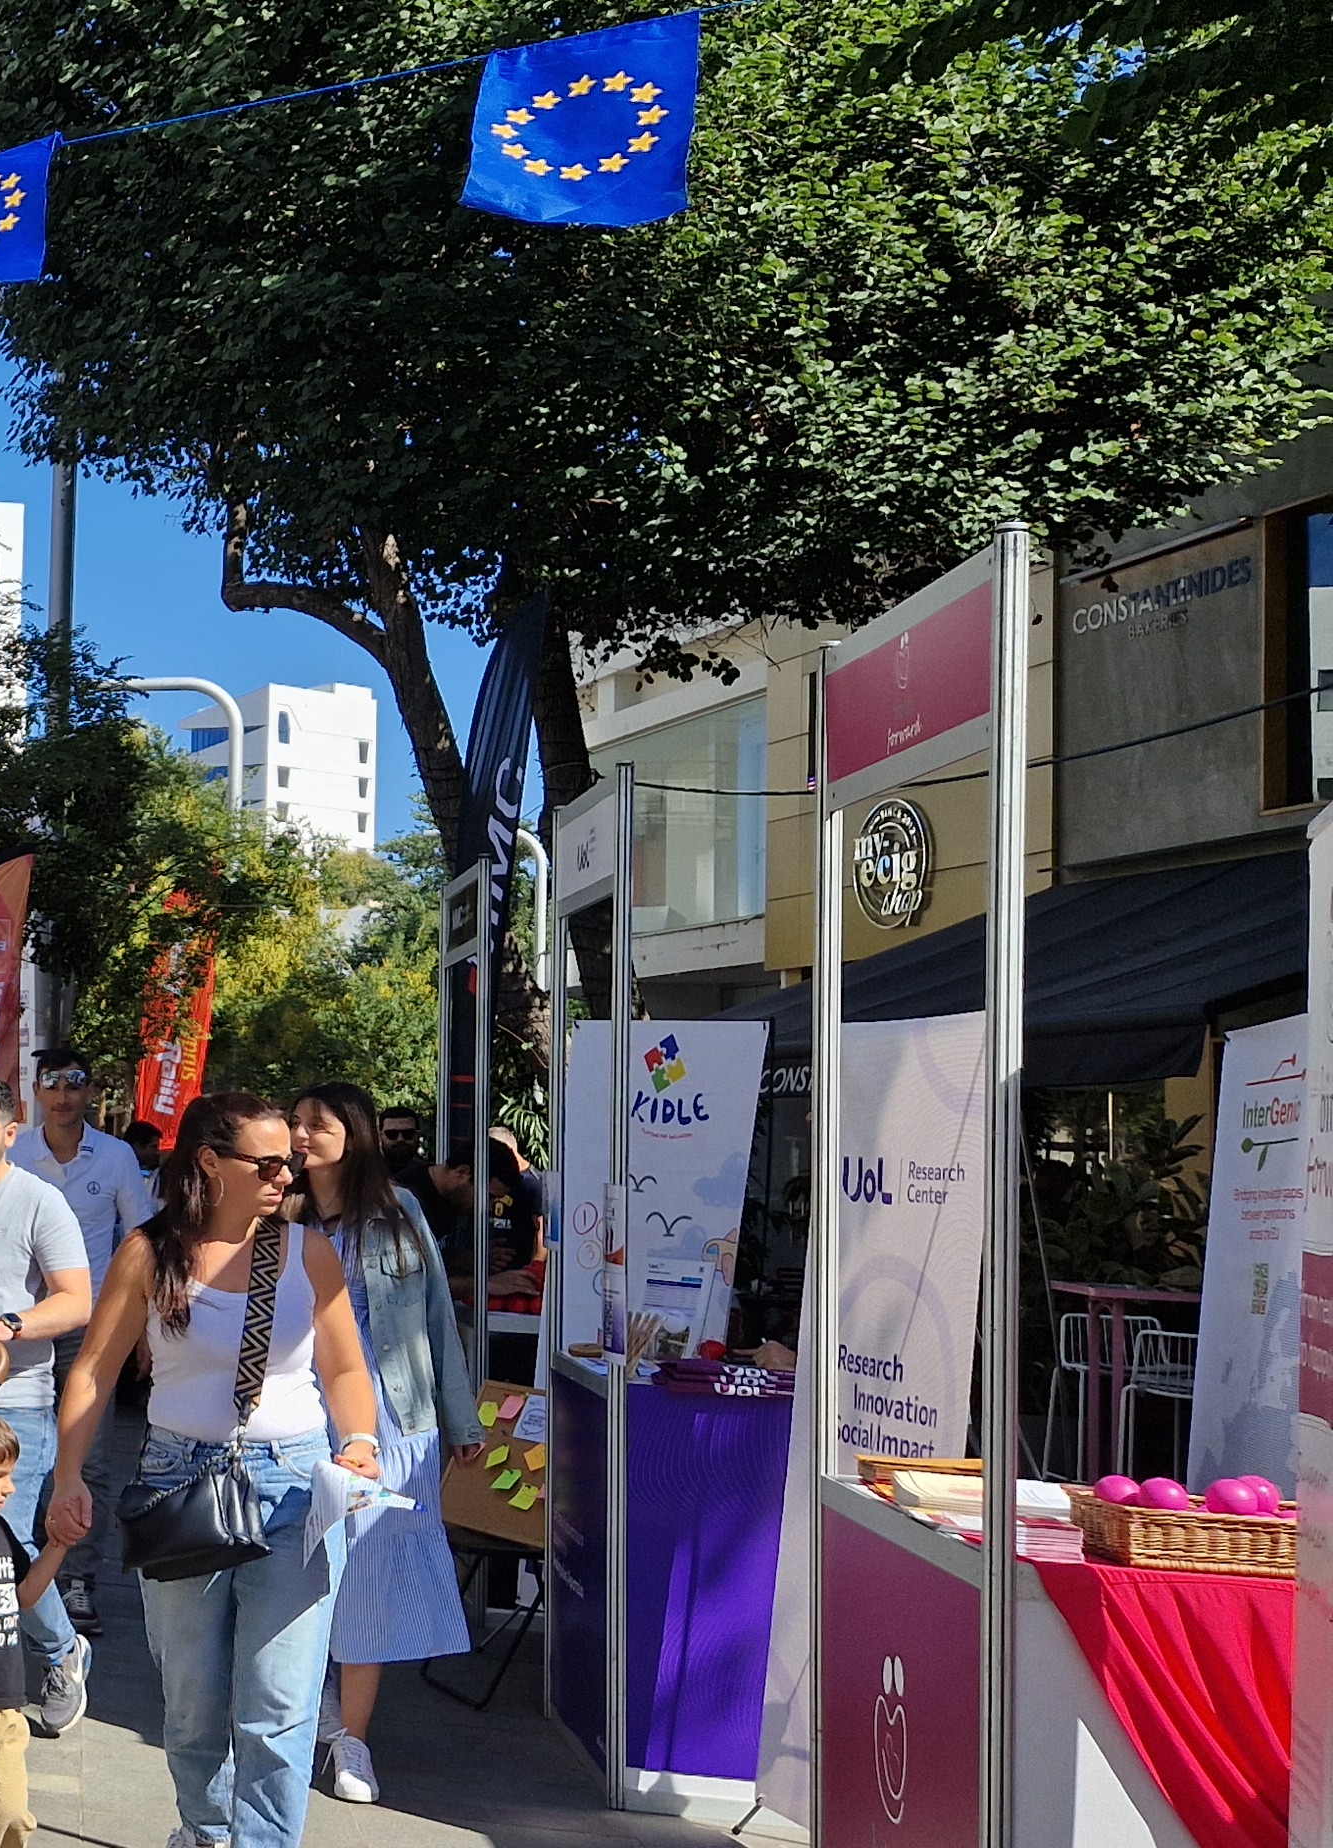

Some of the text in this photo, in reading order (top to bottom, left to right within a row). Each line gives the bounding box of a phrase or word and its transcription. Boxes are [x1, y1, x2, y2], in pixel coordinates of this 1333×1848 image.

[1072, 556, 1252, 635] CONSTANTINIDES
[880, 881, 923, 927] shop
[631, 1090, 710, 1126] KIDLE
[908, 1161, 965, 1182] Research
[907, 1183, 949, 1205] Center
[838, 1343, 904, 1383] Research
[854, 1382, 938, 1429] Innovation
